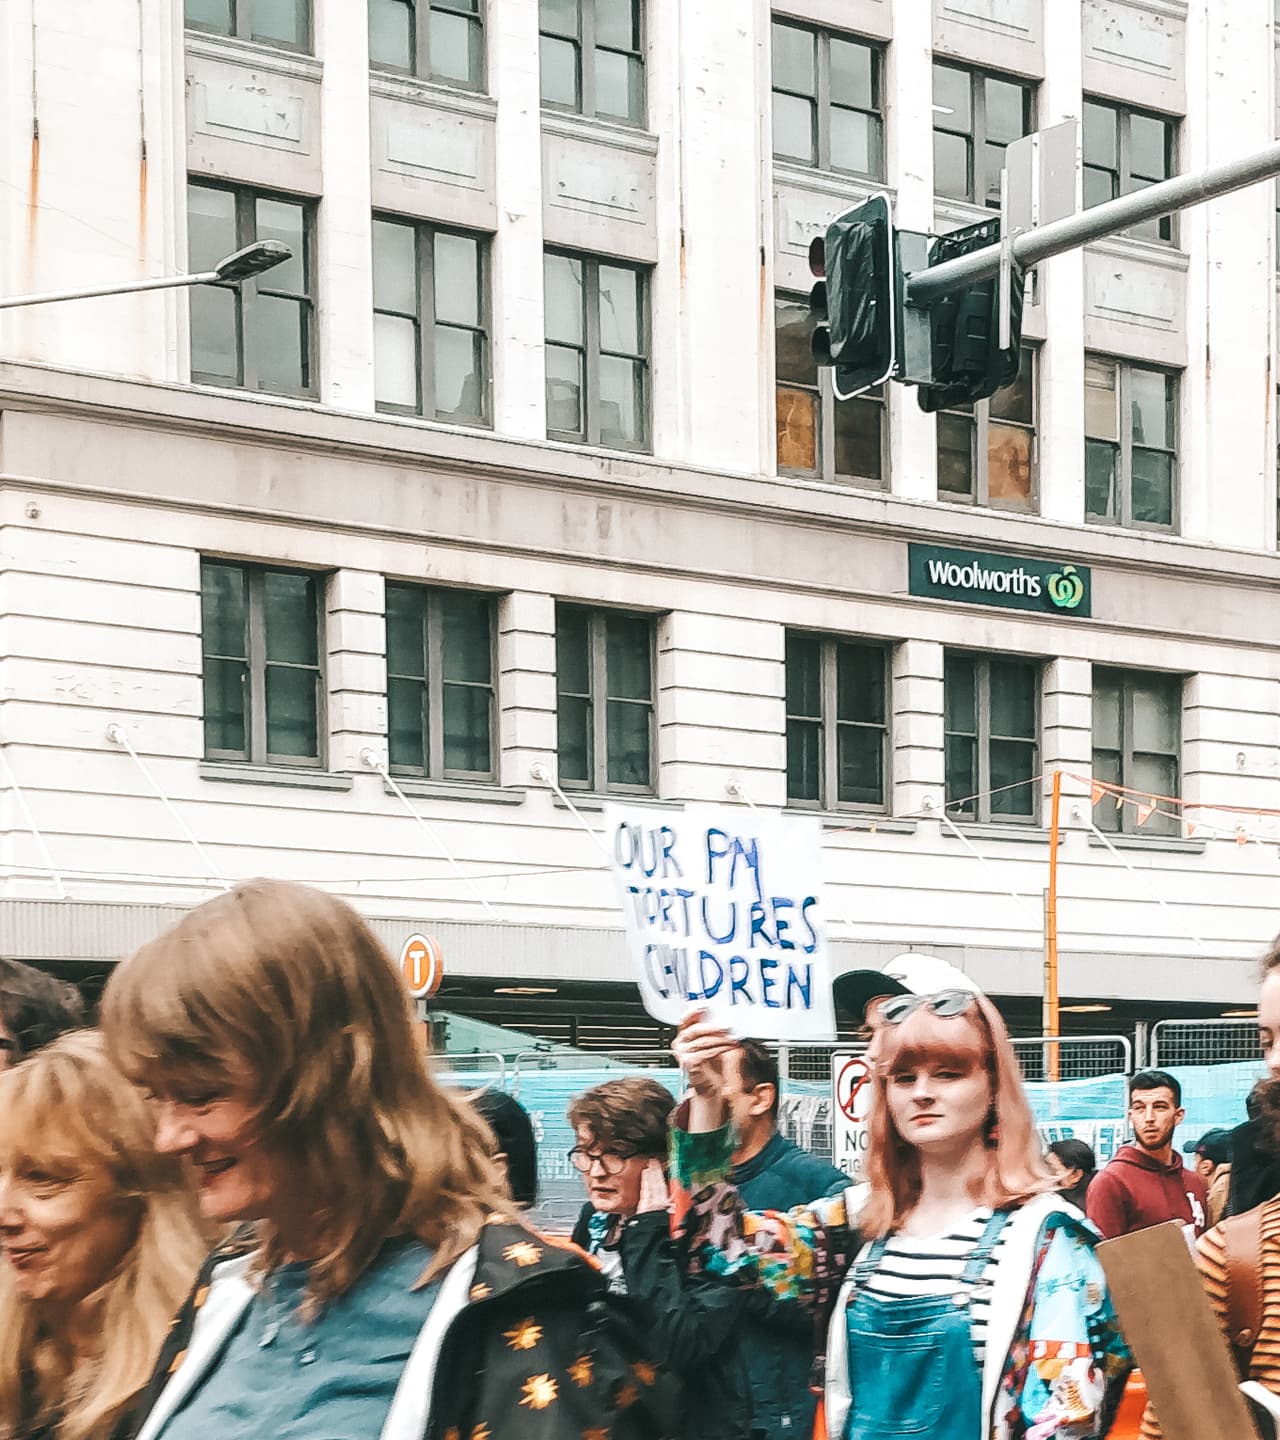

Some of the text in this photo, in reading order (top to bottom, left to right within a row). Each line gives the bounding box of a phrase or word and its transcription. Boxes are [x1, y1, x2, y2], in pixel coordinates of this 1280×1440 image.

[615, 821, 684, 878] OUR
[627, 885, 818, 954] TORTURES
[645, 943, 812, 1009] CHILDREN
[839, 1158, 866, 1174] RIG
